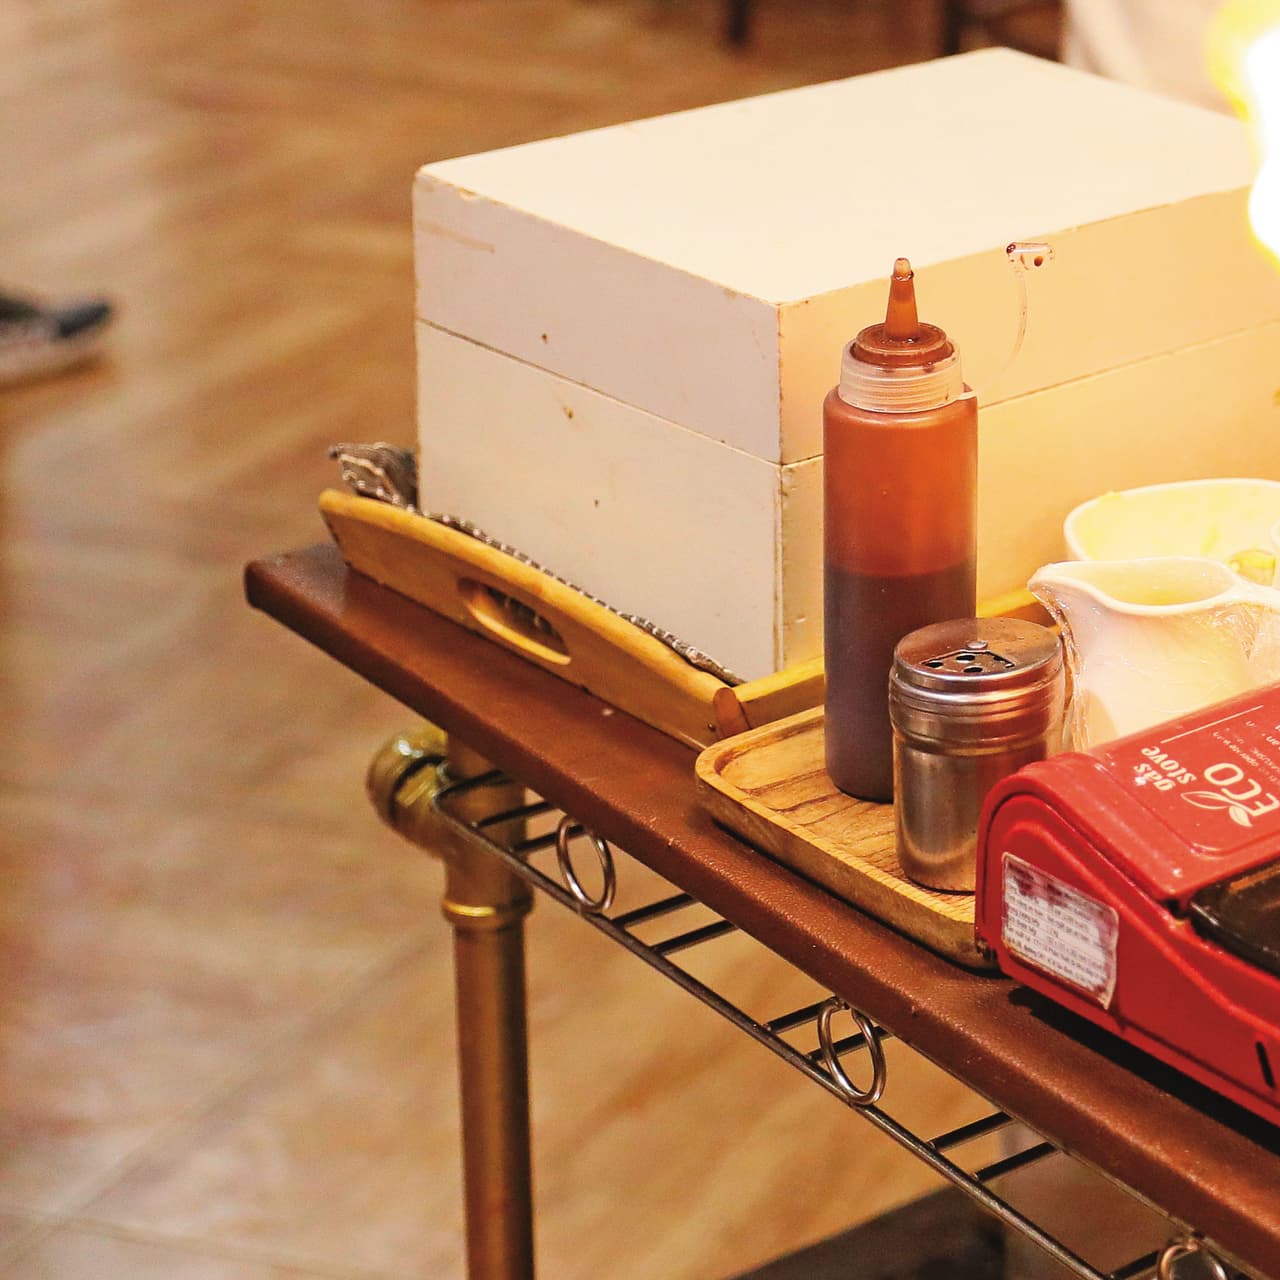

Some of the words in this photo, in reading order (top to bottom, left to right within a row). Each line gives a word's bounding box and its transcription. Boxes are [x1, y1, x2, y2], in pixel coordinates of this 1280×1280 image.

[1133, 763, 1176, 791] gas
[1141, 746, 1197, 785] stove
[1203, 762, 1280, 817] ECO
